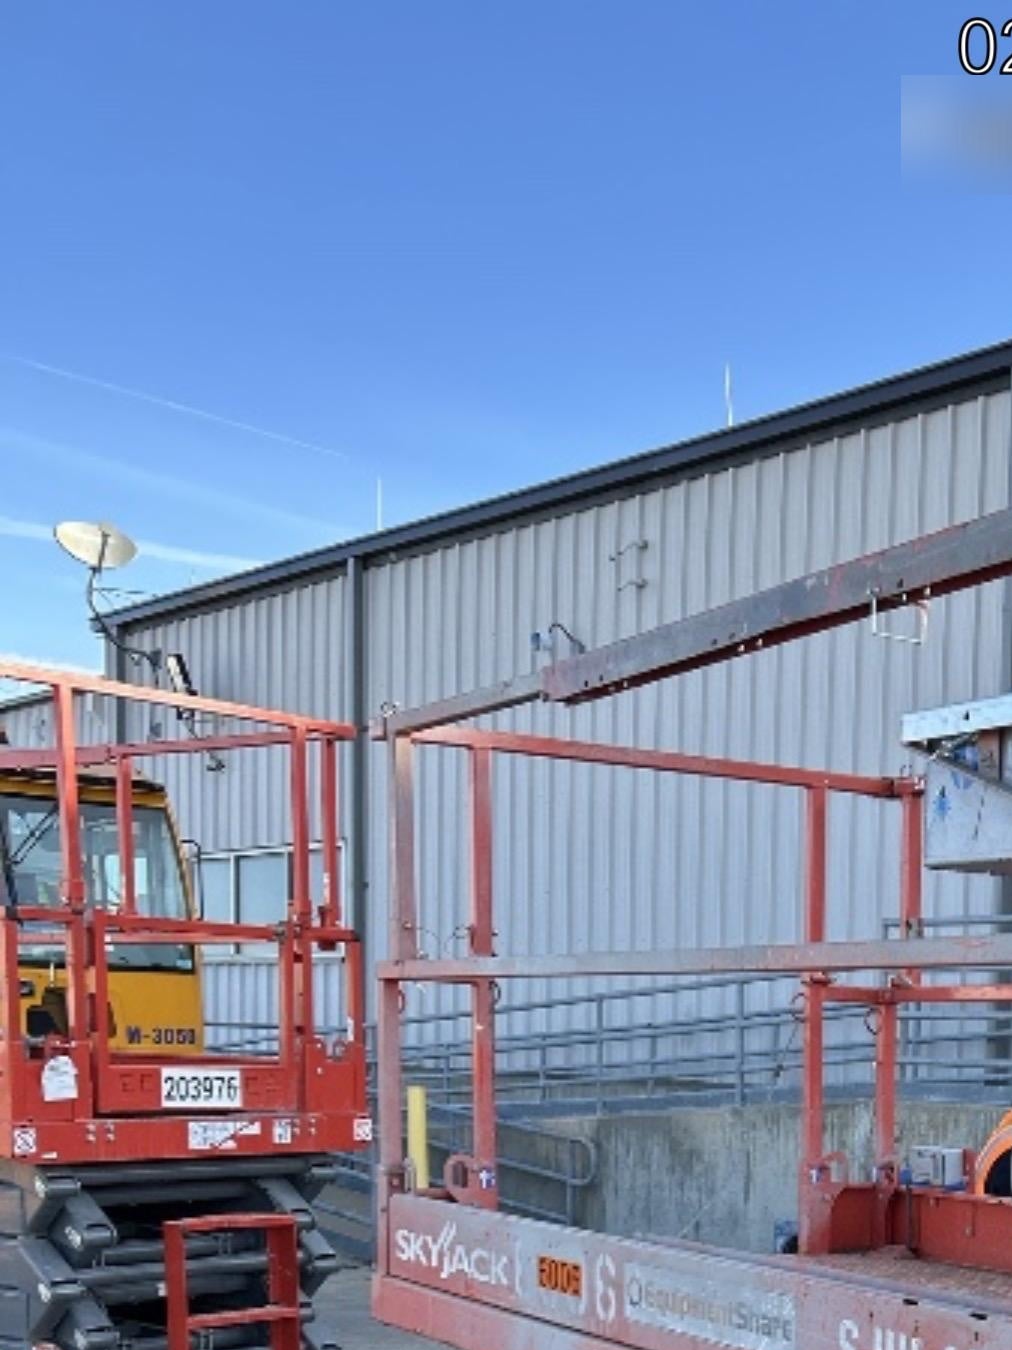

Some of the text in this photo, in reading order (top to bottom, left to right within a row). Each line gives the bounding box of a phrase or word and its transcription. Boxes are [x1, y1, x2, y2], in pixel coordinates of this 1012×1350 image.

[164, 1076, 237, 1102] 203976
[395, 1220, 508, 1286] SKYJACK
[643, 1278, 793, 1342] EquipmentShare
